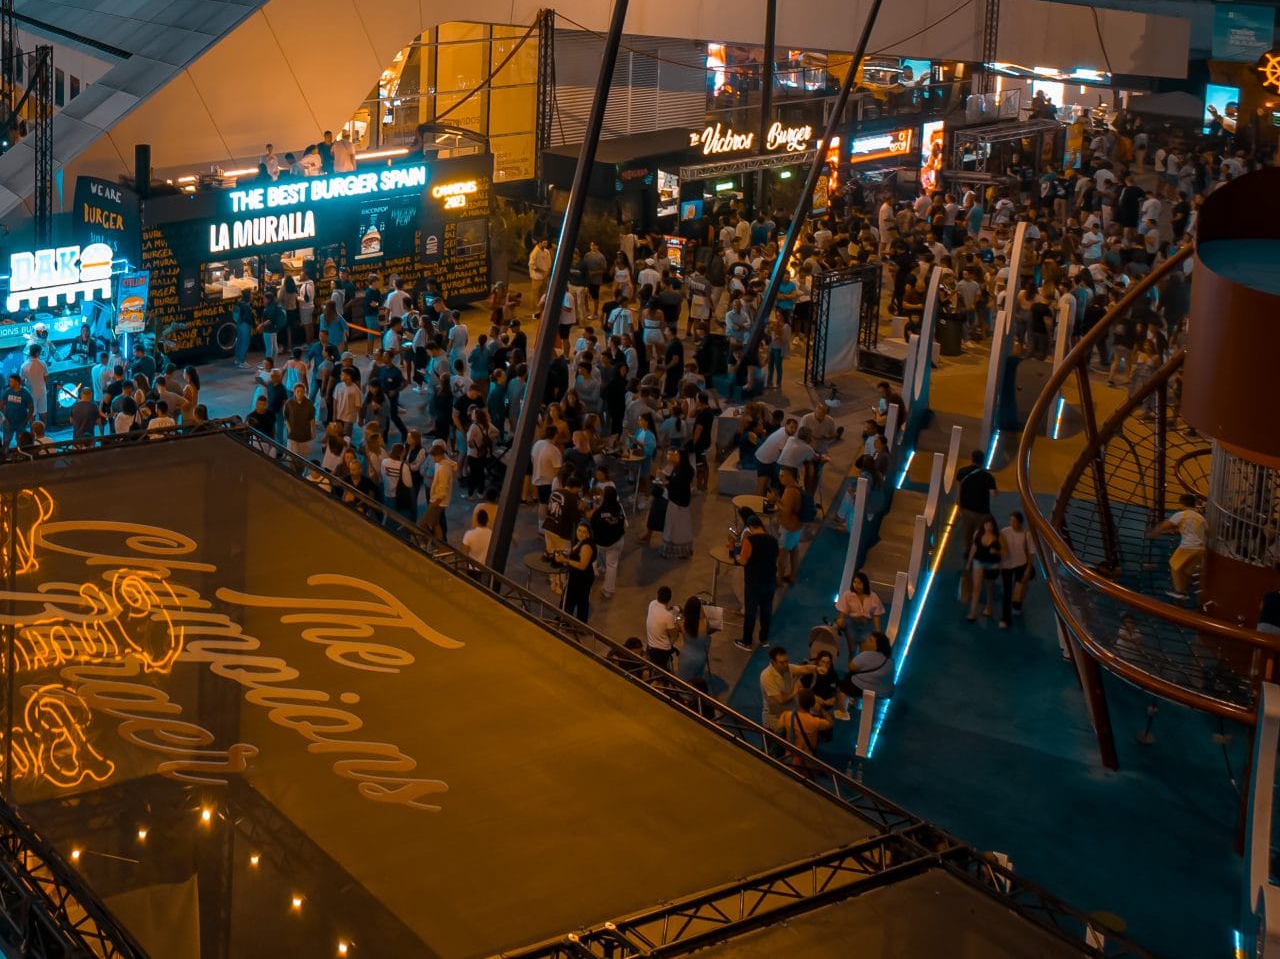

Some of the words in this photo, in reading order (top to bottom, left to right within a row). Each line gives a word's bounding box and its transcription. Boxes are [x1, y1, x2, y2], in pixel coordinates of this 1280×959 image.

[766, 122, 813, 152] Burger
[90, 182, 104, 197] WE
[105, 187, 122, 203] ARE
[229, 188, 265, 213] THE
[267, 181, 310, 207] BEST
[311, 173, 379, 201] BURGER
[380, 165, 426, 191] SPAIN
[84, 202, 124, 231] BURGER
[209, 222, 231, 253] LA
[233, 210, 316, 249] MURALLA
[10, 245, 82, 292] DAK
[216, 573, 466, 674] The
[38, 520, 450, 812] Champions
